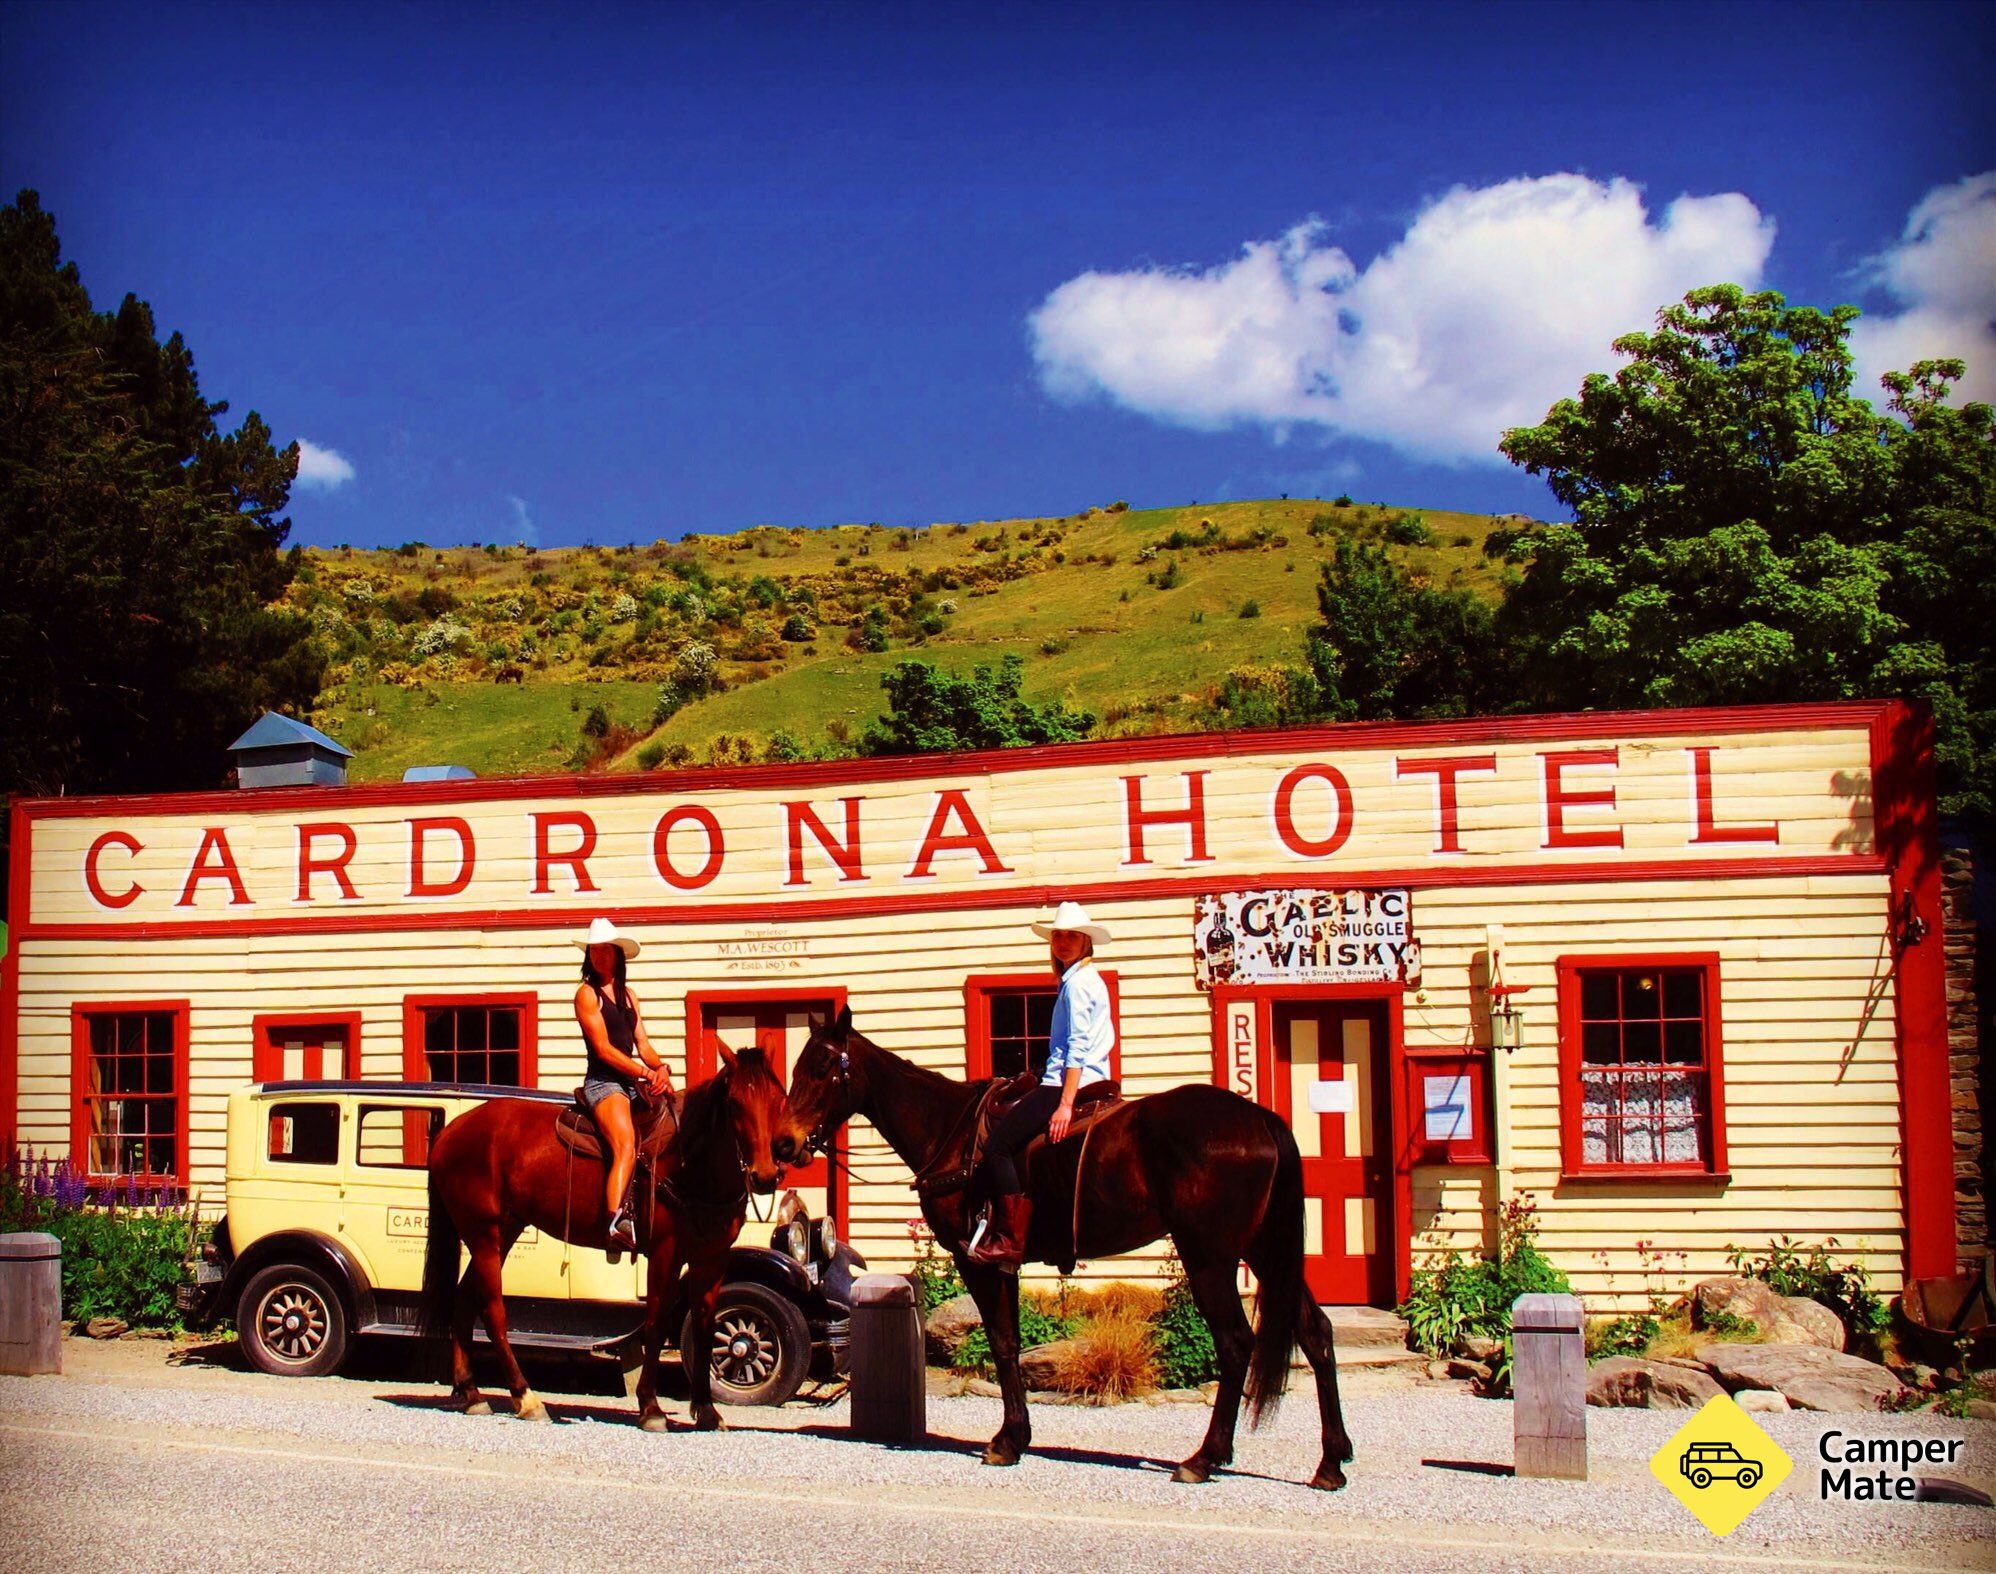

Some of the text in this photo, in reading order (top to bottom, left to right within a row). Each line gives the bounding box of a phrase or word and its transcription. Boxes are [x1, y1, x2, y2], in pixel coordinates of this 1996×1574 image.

[85, 746, 1778, 909] CARDRONA HOTEL
[1240, 893, 1405, 938] GAELIC
[1264, 941, 1407, 967] WHISKY
[1234, 1014, 1253, 1100] RES
